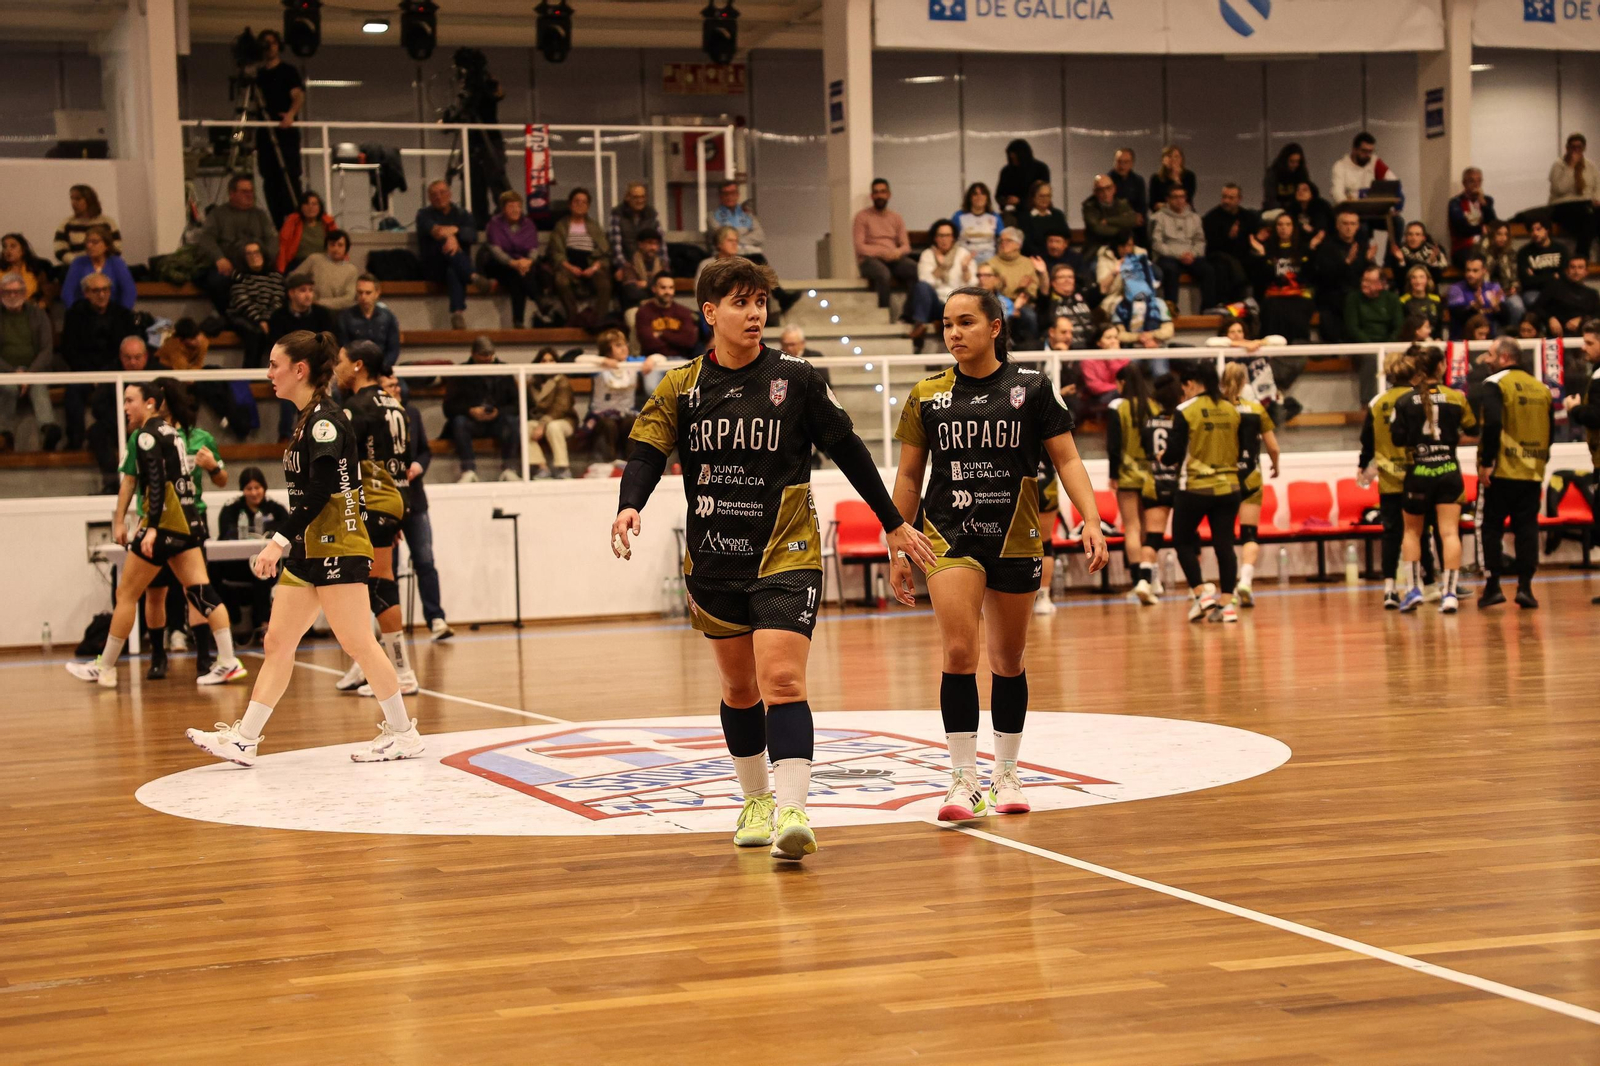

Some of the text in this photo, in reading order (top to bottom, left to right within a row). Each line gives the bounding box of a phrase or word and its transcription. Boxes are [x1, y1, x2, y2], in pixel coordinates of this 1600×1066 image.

[975, 0, 1114, 20] DE GALICIA
[1563, 0, 1592, 21] DE
[687, 385, 701, 408] 11
[385, 408, 406, 455] 10
[688, 417, 781, 452] ORPAGU
[938, 419, 1021, 451] ORPAGU
[1153, 428, 1168, 455] 6
[713, 464, 745, 474] XUNTA
[963, 461, 993, 470] XUNTA
[963, 470, 1011, 479] DE GALICIA
[711, 475, 765, 486] DE GALICIA
[974, 491, 1011, 499] Deputación
[717, 499, 764, 510] Deputación
[716, 508, 763, 517] Pontevedra
[722, 537, 750, 546] MONTE
[730, 544, 754, 552] TECLA
[806, 586, 817, 609] 11
